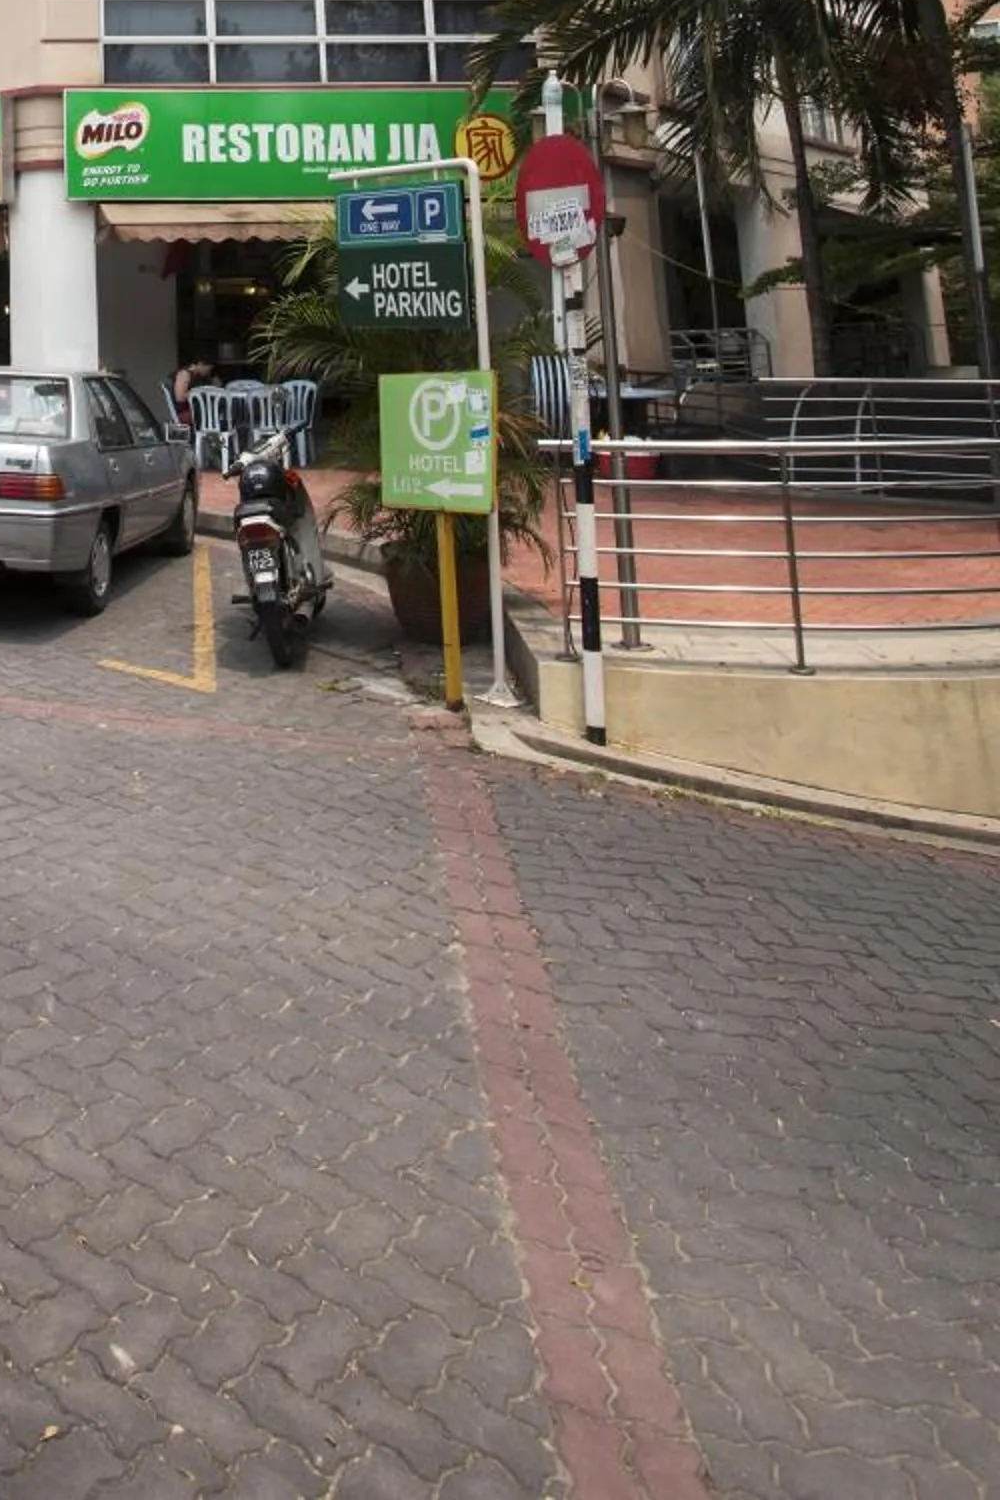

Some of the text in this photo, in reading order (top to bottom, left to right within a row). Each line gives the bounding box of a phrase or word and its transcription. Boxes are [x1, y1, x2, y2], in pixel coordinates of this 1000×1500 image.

[81, 121, 143, 146] MILO
[182, 122, 442, 163] RESTORAN JIA
[465, 123, 506, 168] 家
[360, 219, 400, 233] ONE WAY
[424, 199, 440, 225] P
[372, 261, 438, 289] HOTEL
[373, 290, 463, 318] PARKING
[421, 390, 447, 437] P
[409, 454, 462, 473] HOTEL
